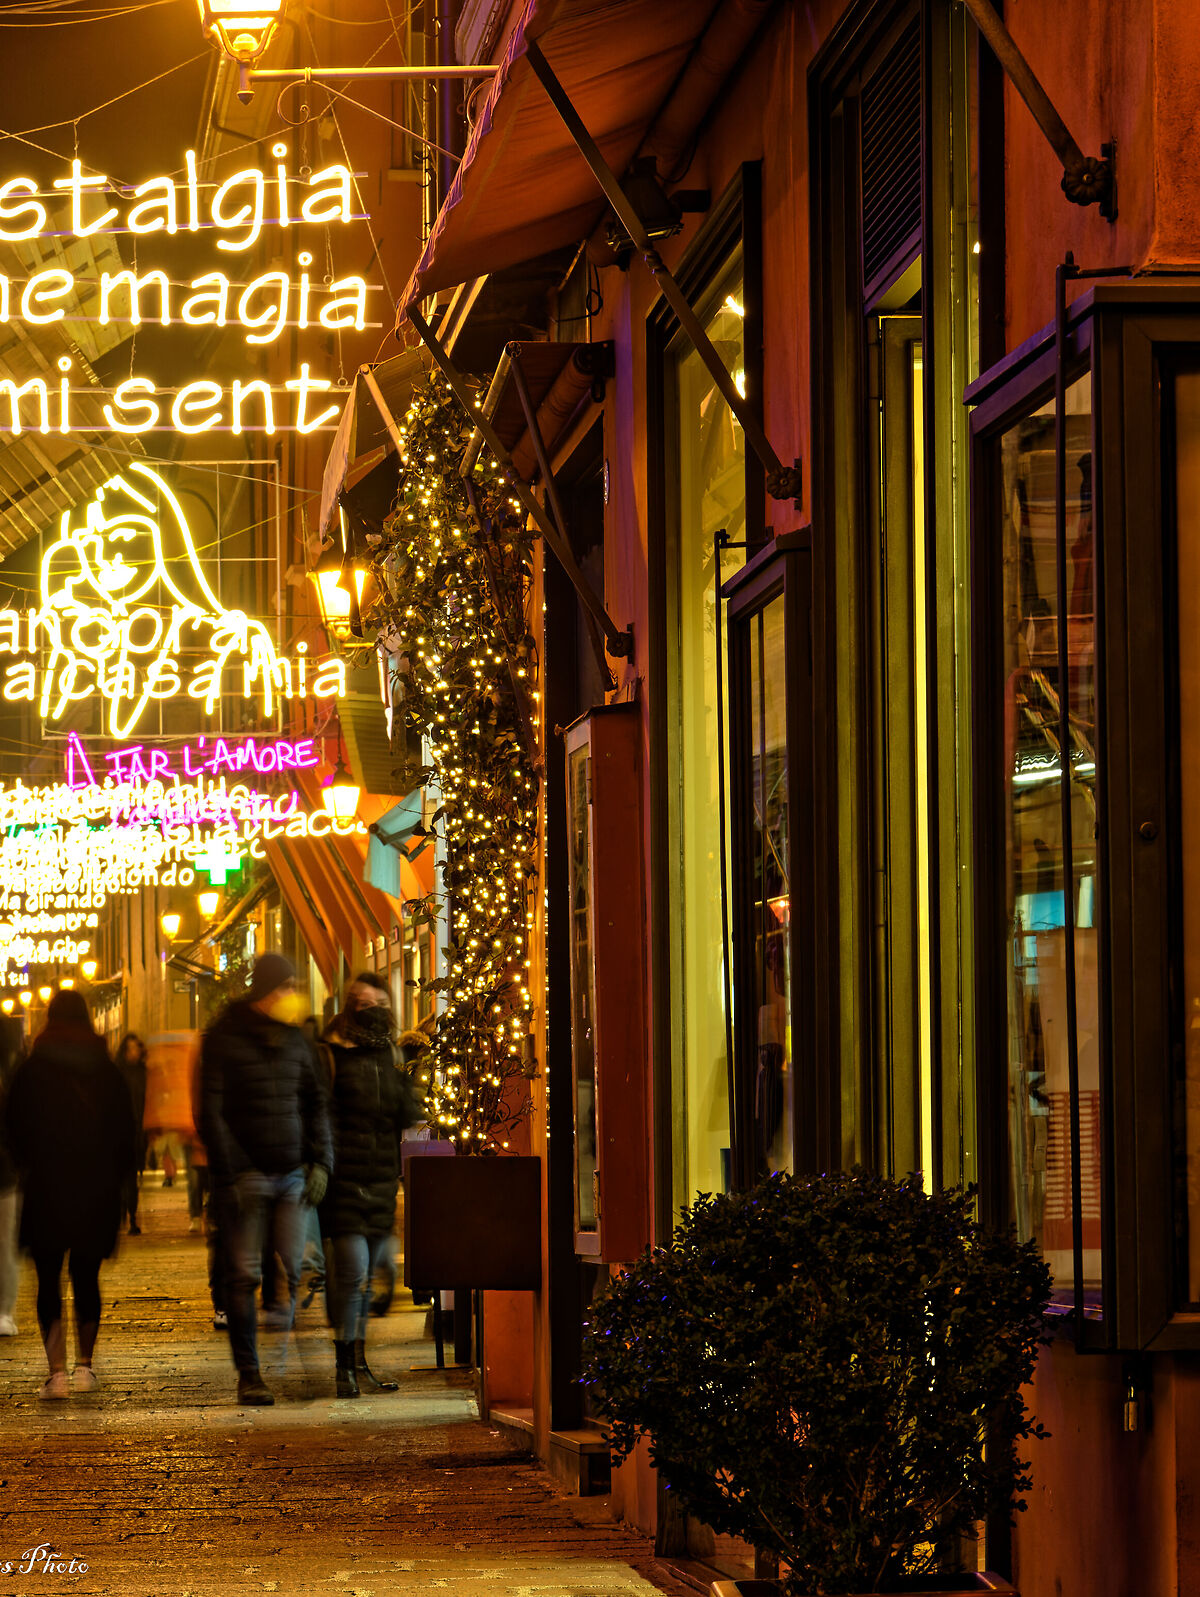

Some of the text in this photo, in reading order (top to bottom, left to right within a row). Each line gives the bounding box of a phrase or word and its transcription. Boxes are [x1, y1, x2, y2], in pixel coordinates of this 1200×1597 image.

[98, 251, 367, 345] magia
[102, 362, 340, 436] sent
[105, 744, 178, 788] FAR
[182, 734, 320, 777] L'AMORE
